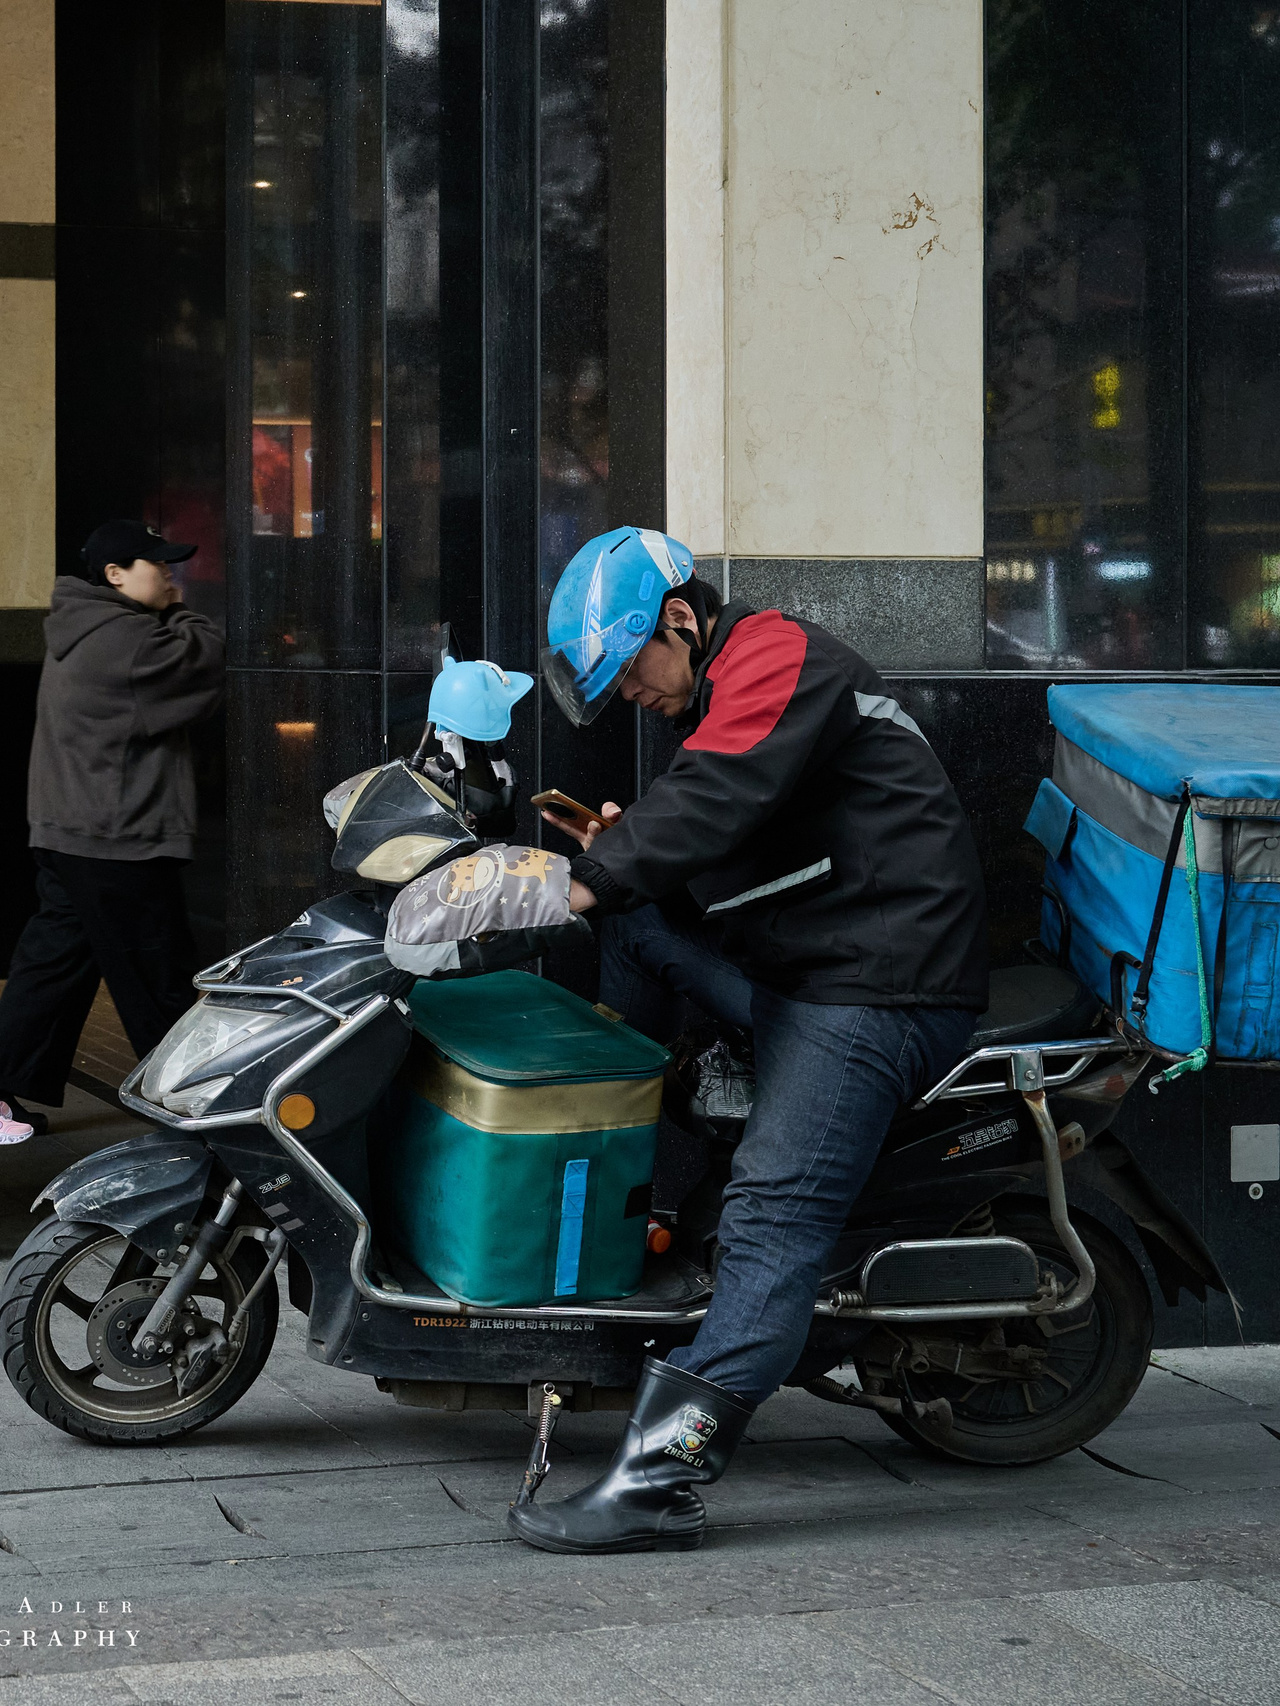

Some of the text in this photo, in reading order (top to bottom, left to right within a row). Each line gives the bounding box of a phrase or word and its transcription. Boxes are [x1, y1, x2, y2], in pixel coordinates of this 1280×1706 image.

[963, 1146, 983, 1155] ELECTRIC
[984, 1140, 1002, 1148] FASHION
[470, 1318, 595, 1331] 浙江钻豹电动车有限公司
[664, 1444, 704, 1468] ZHENG LI
